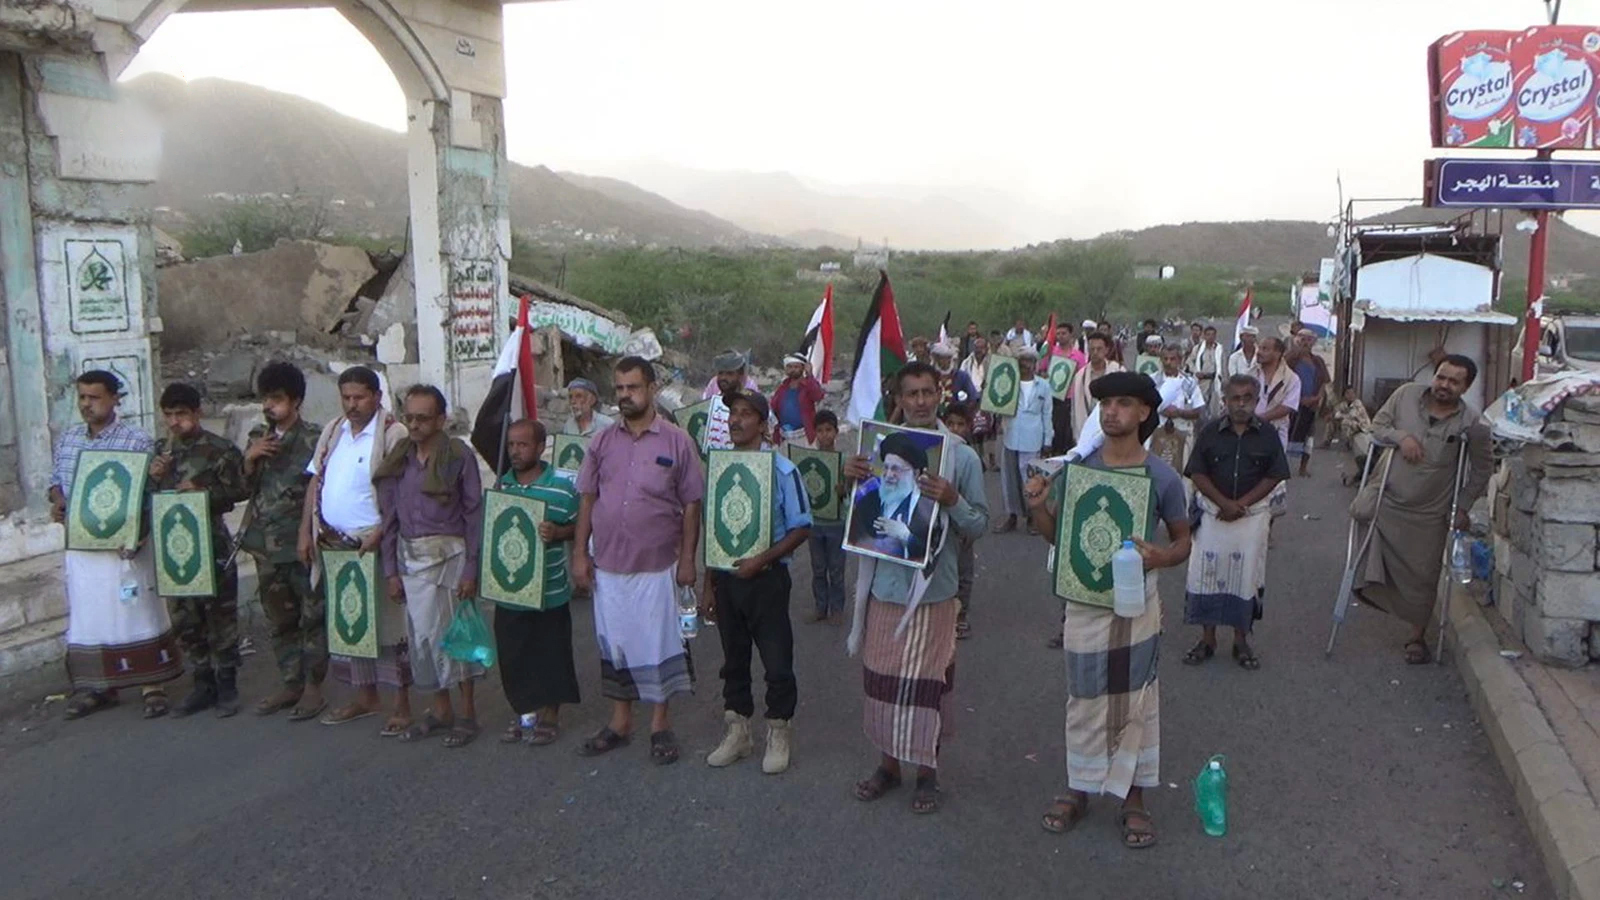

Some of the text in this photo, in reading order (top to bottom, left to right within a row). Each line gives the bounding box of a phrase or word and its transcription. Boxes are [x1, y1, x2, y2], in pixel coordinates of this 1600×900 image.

[1447, 71, 1510, 107] Crystal
[1518, 69, 1587, 107] Crystal
[1451, 174, 1560, 193] منطقة الهجر
